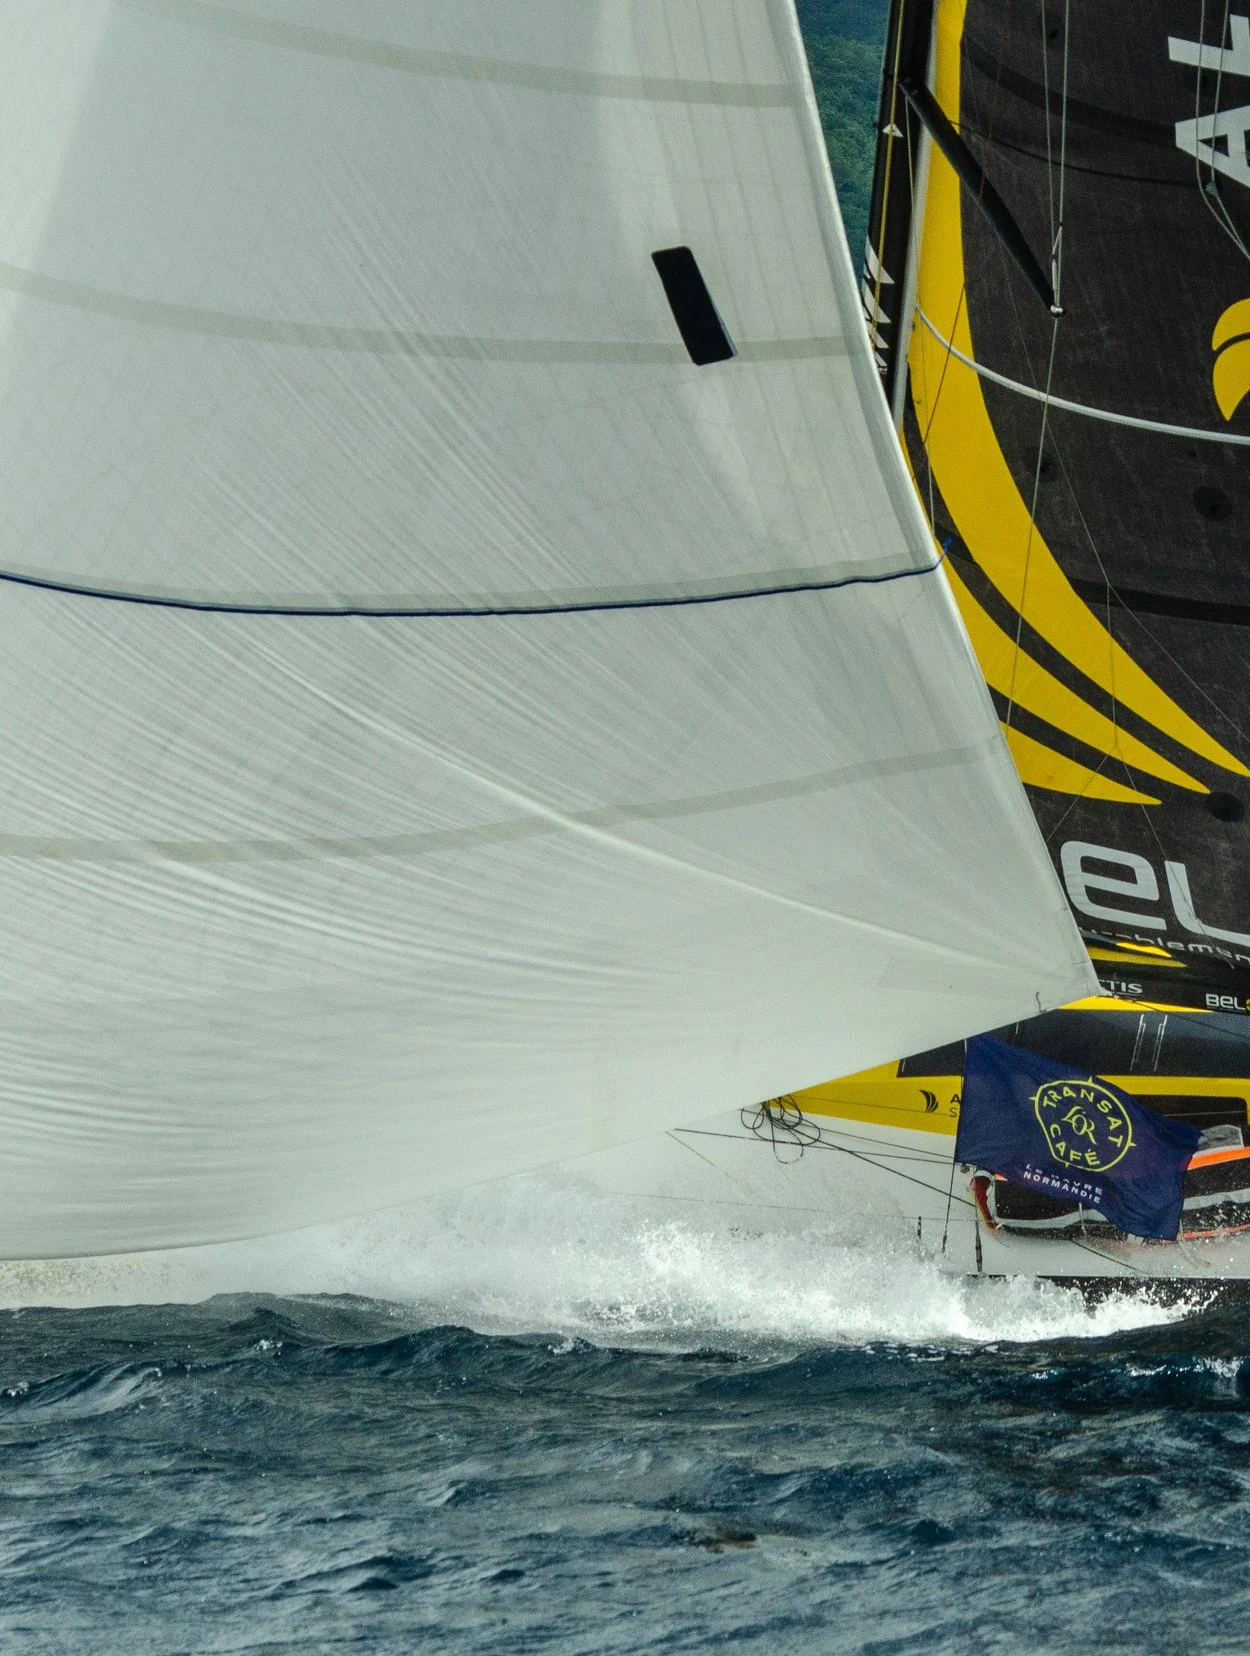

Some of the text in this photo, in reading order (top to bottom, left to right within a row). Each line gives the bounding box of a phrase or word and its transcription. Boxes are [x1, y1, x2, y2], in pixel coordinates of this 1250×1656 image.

[1099, 979, 1143, 994] TIS
[1043, 1086, 1123, 1147] TRANSAT
[1050, 1124, 1100, 1165] CAFÉ
[1023, 1171, 1101, 1204] NORMANDIE
